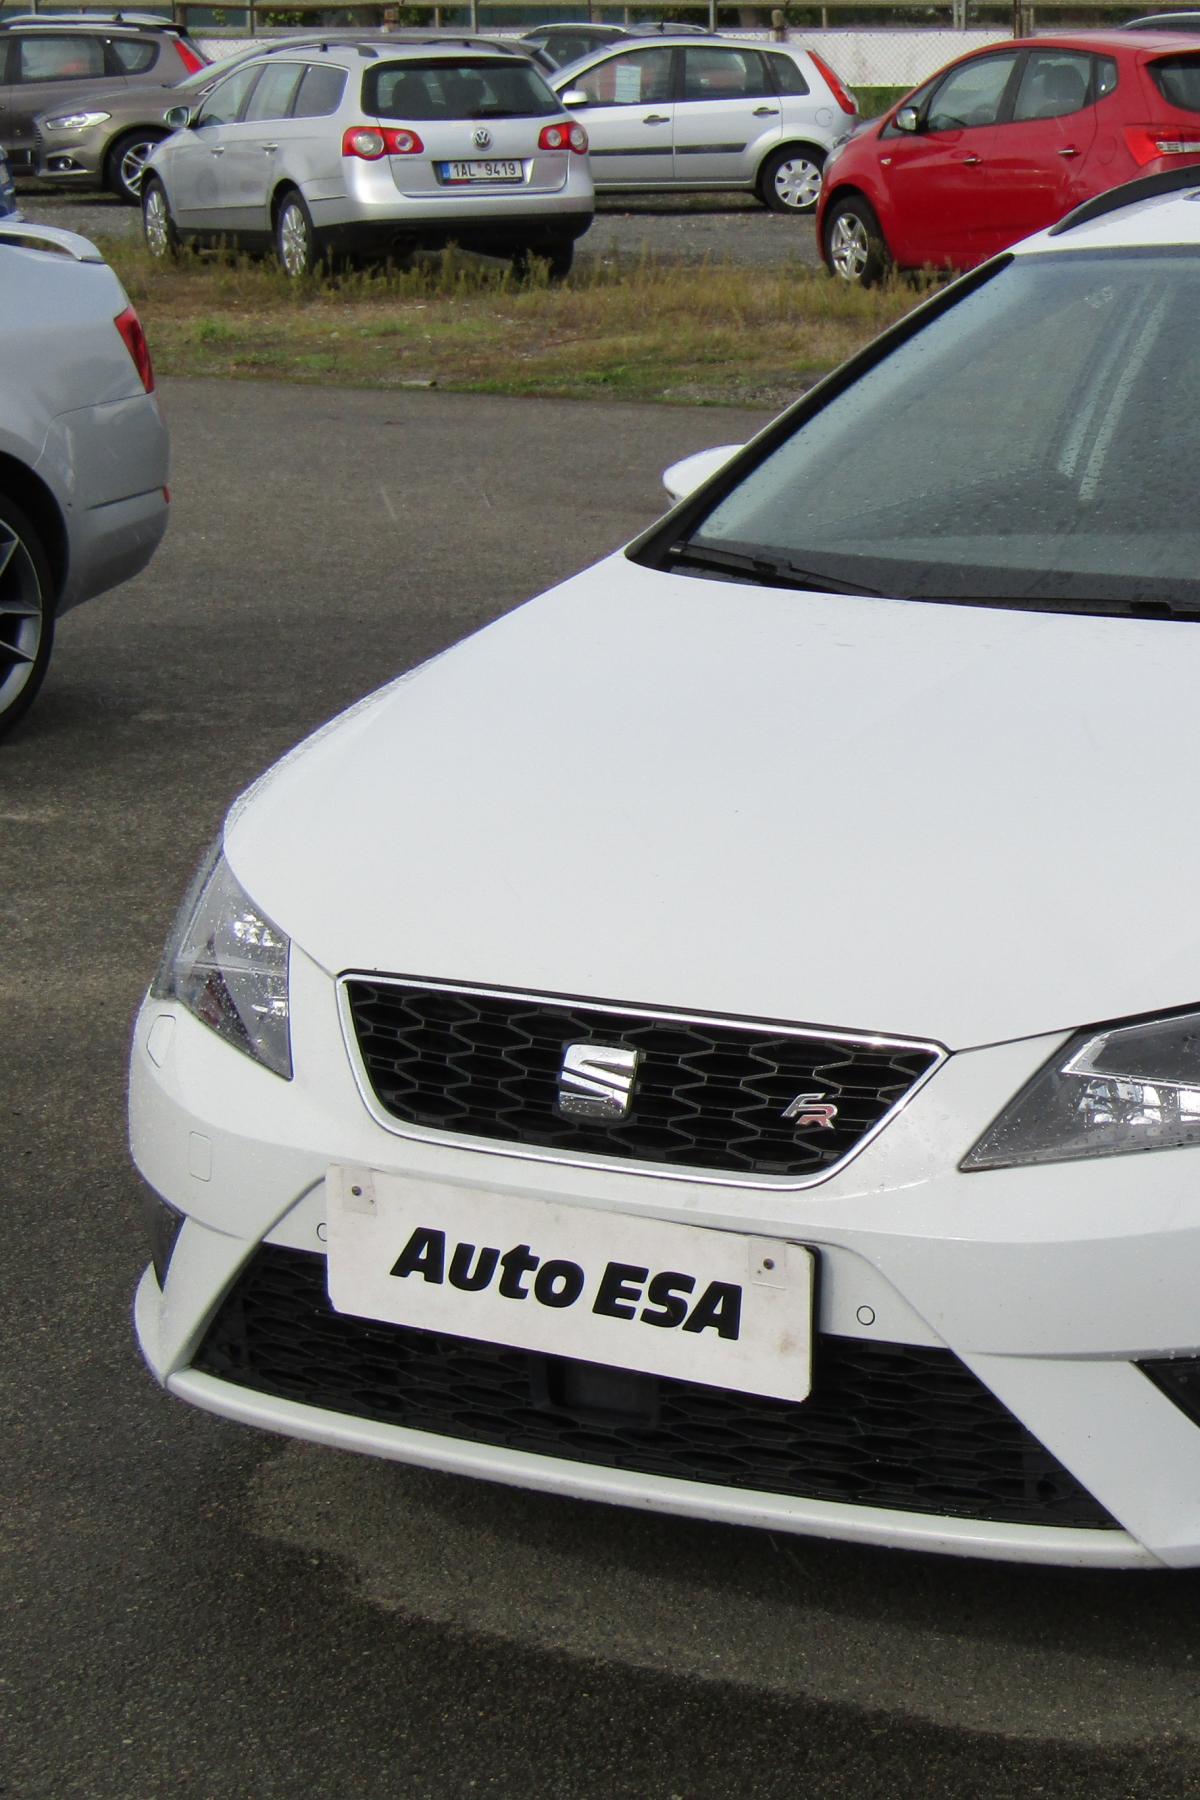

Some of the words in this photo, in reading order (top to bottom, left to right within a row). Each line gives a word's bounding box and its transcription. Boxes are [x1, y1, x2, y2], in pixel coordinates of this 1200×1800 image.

[453, 162, 476, 177] 1AL
[484, 161, 517, 176] 9419
[780, 1092, 839, 1129] FR
[389, 1226, 586, 1308] Auto
[592, 1261, 743, 1341] ESA
